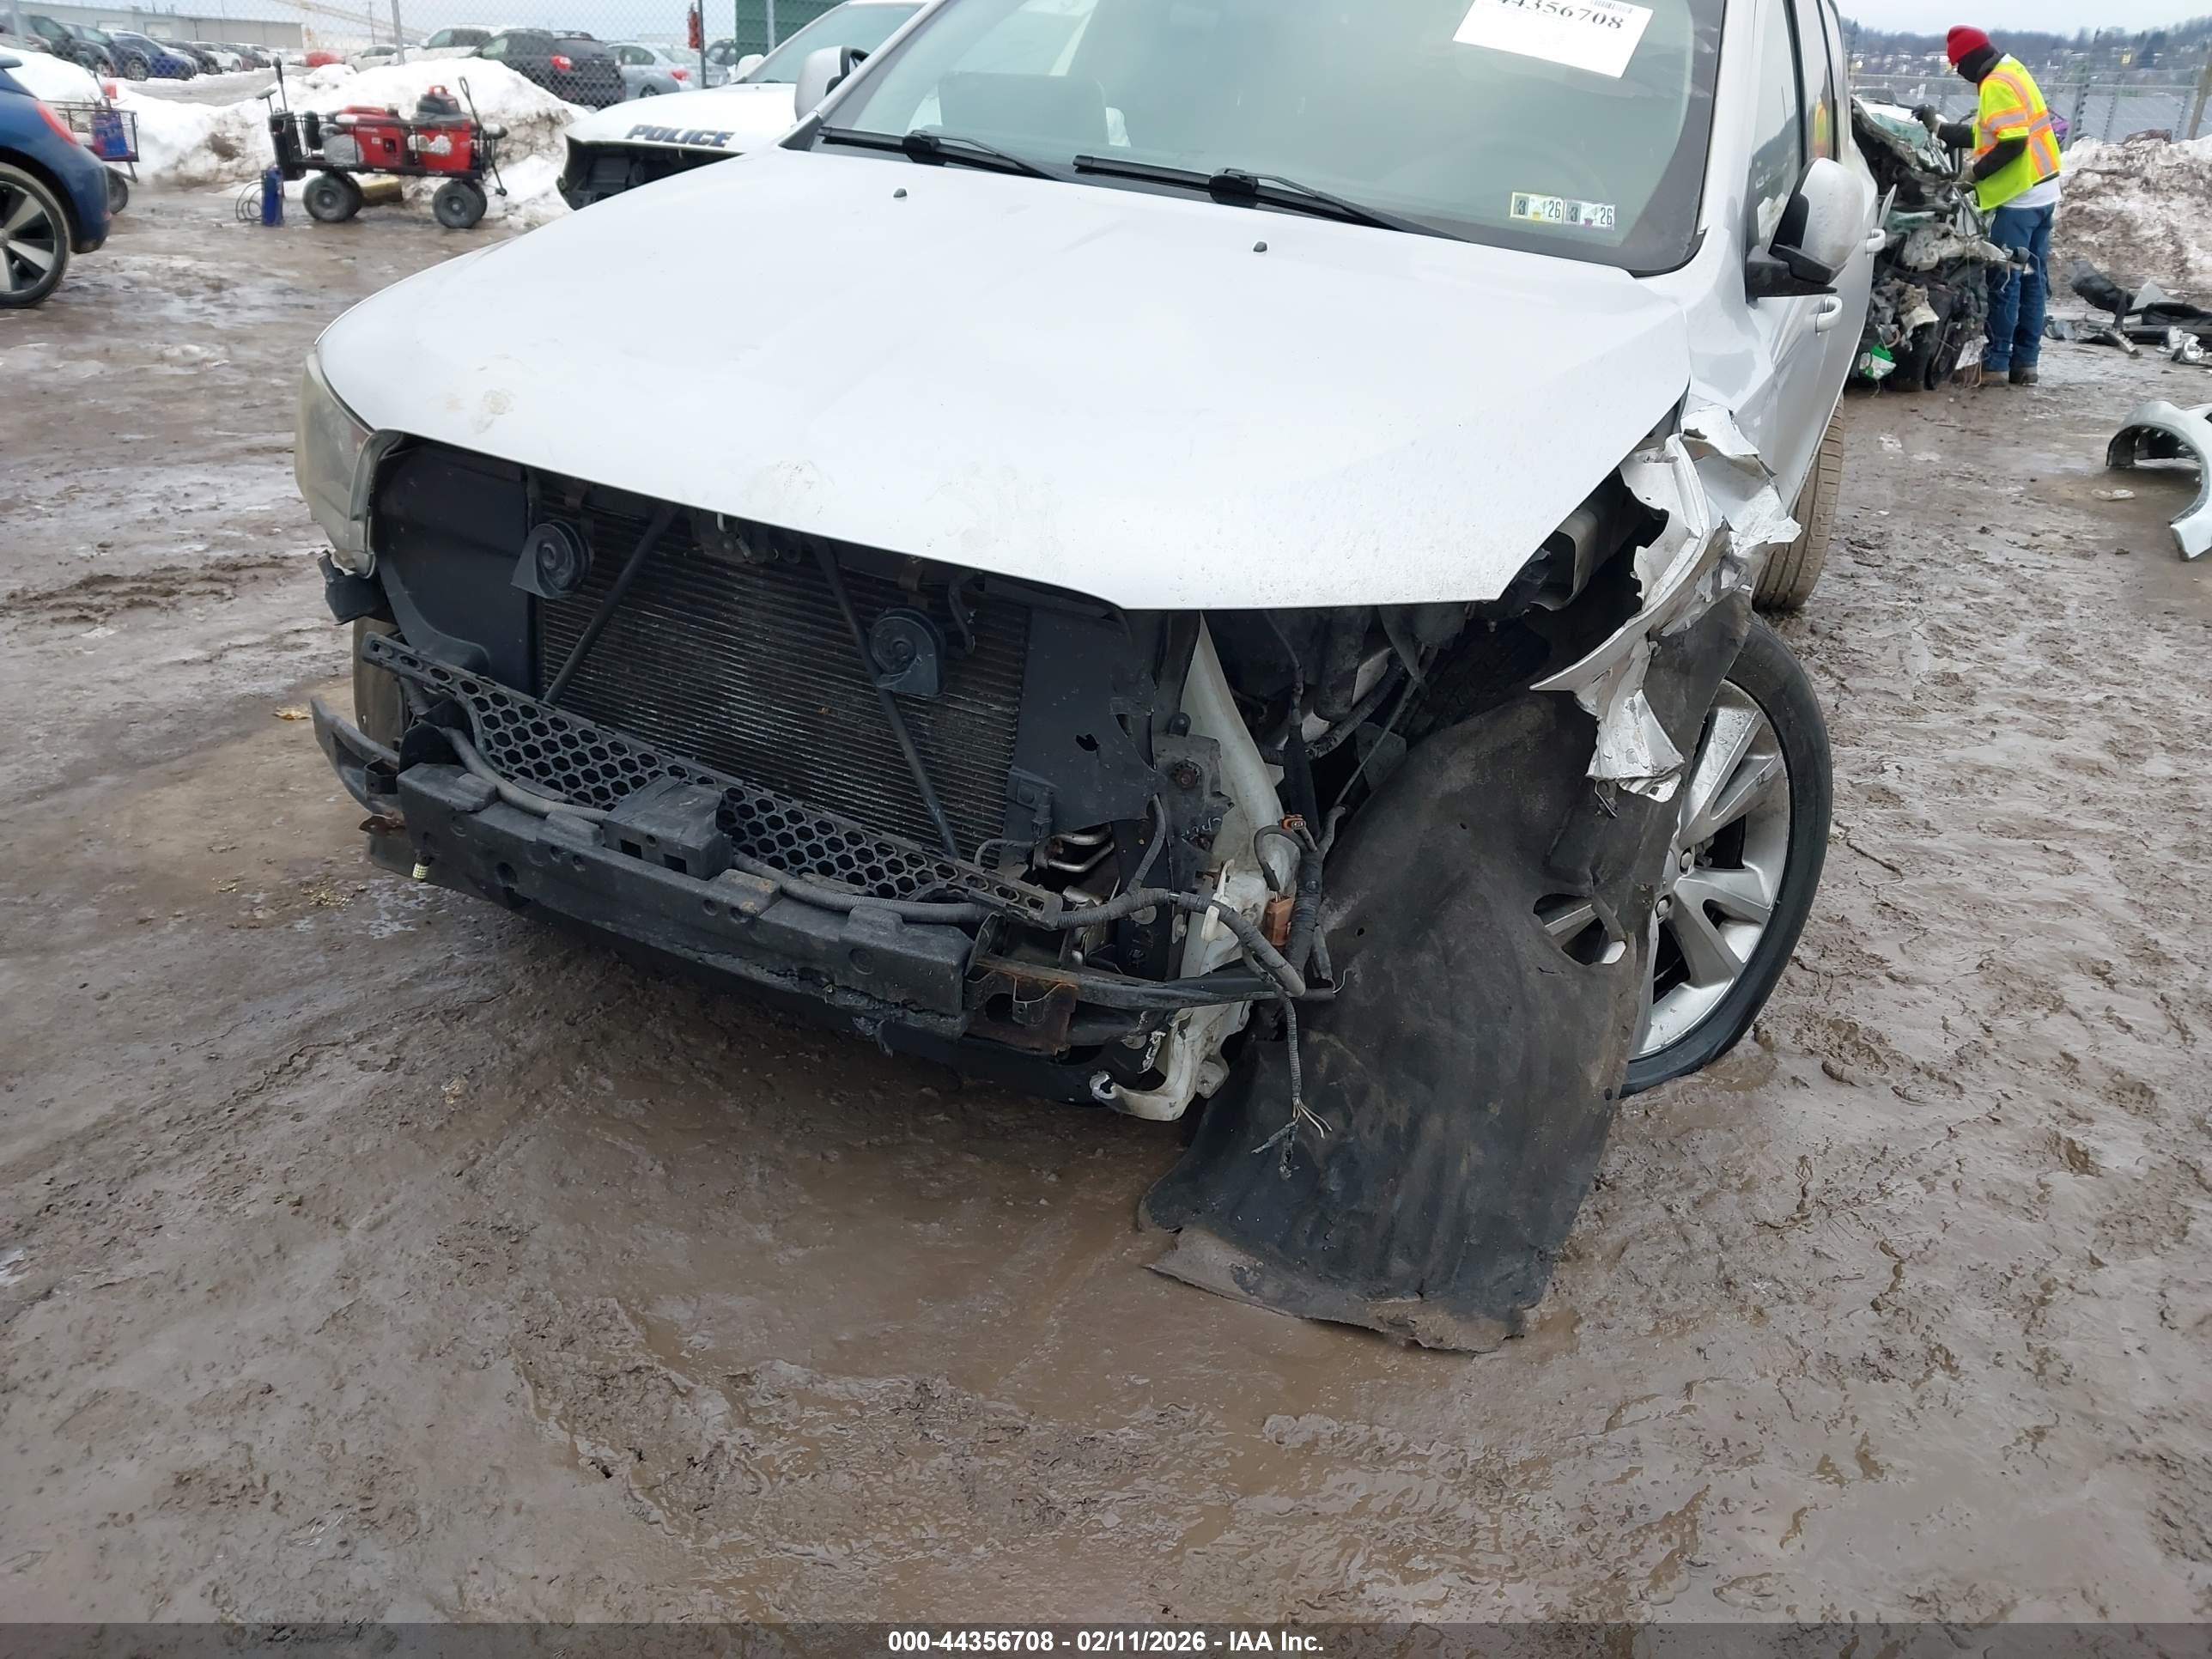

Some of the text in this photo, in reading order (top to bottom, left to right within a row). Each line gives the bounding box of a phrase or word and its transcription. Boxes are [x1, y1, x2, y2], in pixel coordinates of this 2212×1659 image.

[1498, 0, 1624, 29] 4356708
[625, 124, 735, 148] POLICE
[1548, 200, 1562, 219] 26
[1600, 207, 1613, 226] 26
